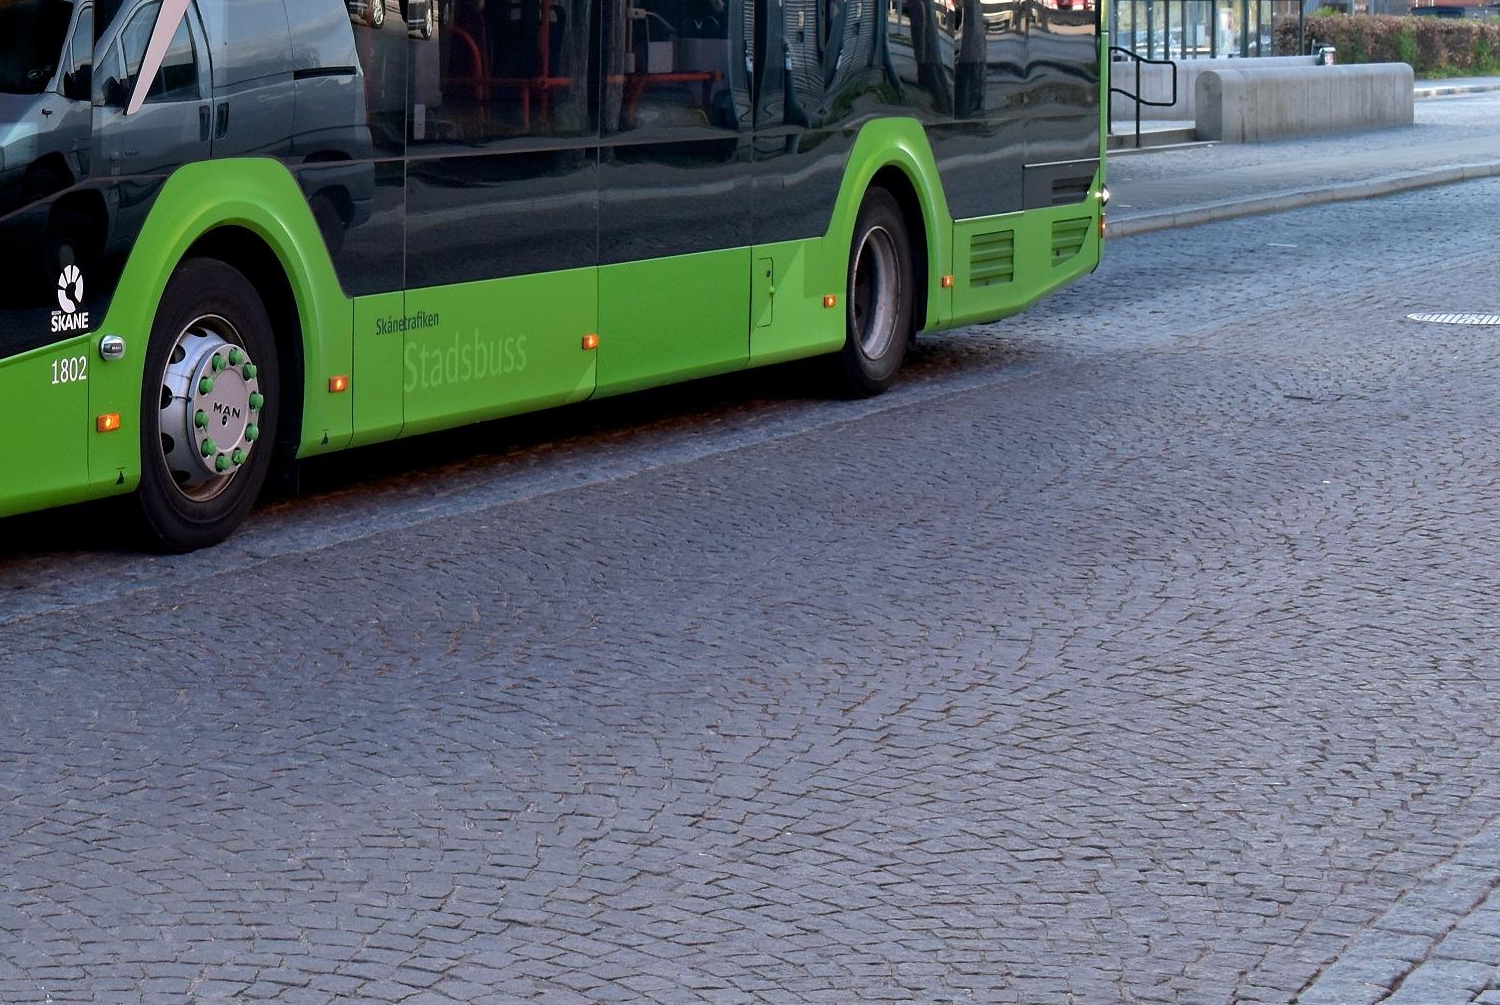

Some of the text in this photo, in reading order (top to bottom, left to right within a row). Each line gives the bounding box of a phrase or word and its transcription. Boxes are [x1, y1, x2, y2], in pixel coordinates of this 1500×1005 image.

[376, 310, 439, 336] Skånetrafiken
[51, 355, 87, 385] 1802
[403, 328, 527, 393] Stadsbuss
[213, 401, 241, 419] MAN
